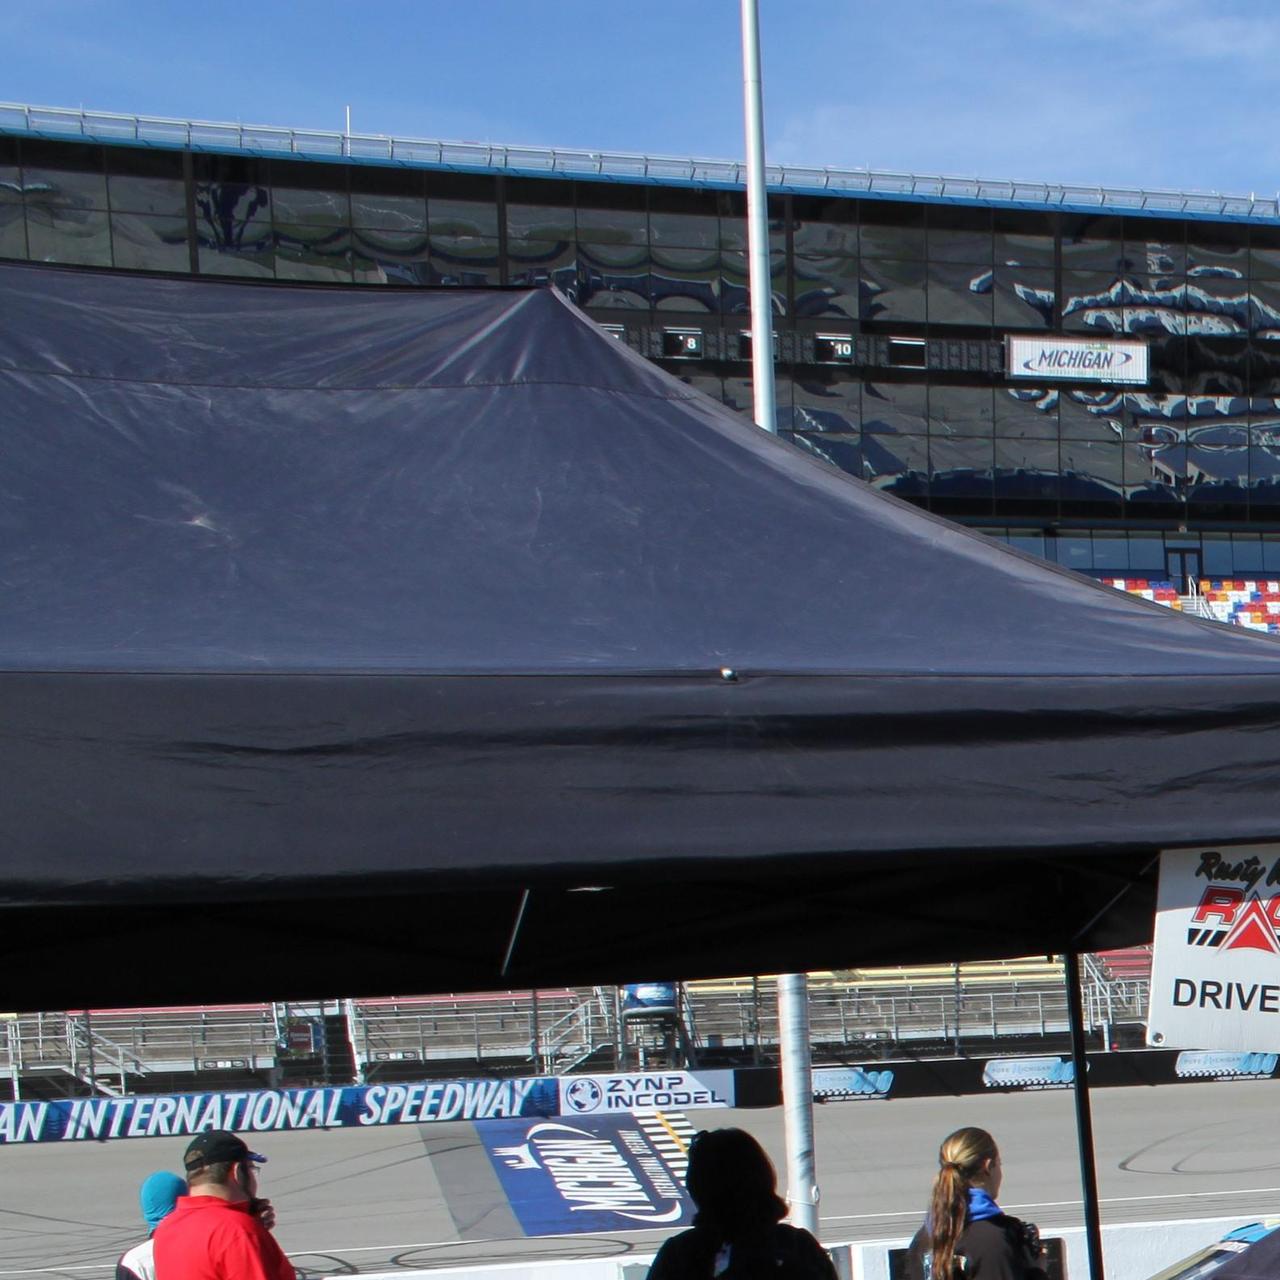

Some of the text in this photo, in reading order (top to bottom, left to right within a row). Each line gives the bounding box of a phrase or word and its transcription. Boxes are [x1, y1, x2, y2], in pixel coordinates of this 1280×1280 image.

[1038, 349, 1114, 369] MICHIGAN
[1195, 851, 1266, 893] Rusty
[607, 1077, 684, 1092] ZYNP
[607, 1089, 727, 1109] INCODEL
[63, 1087, 344, 1140] INTERNATIONAL
[358, 1078, 535, 1126] SPEEDWAY
[532, 1137, 656, 1212] MICHIGAN
